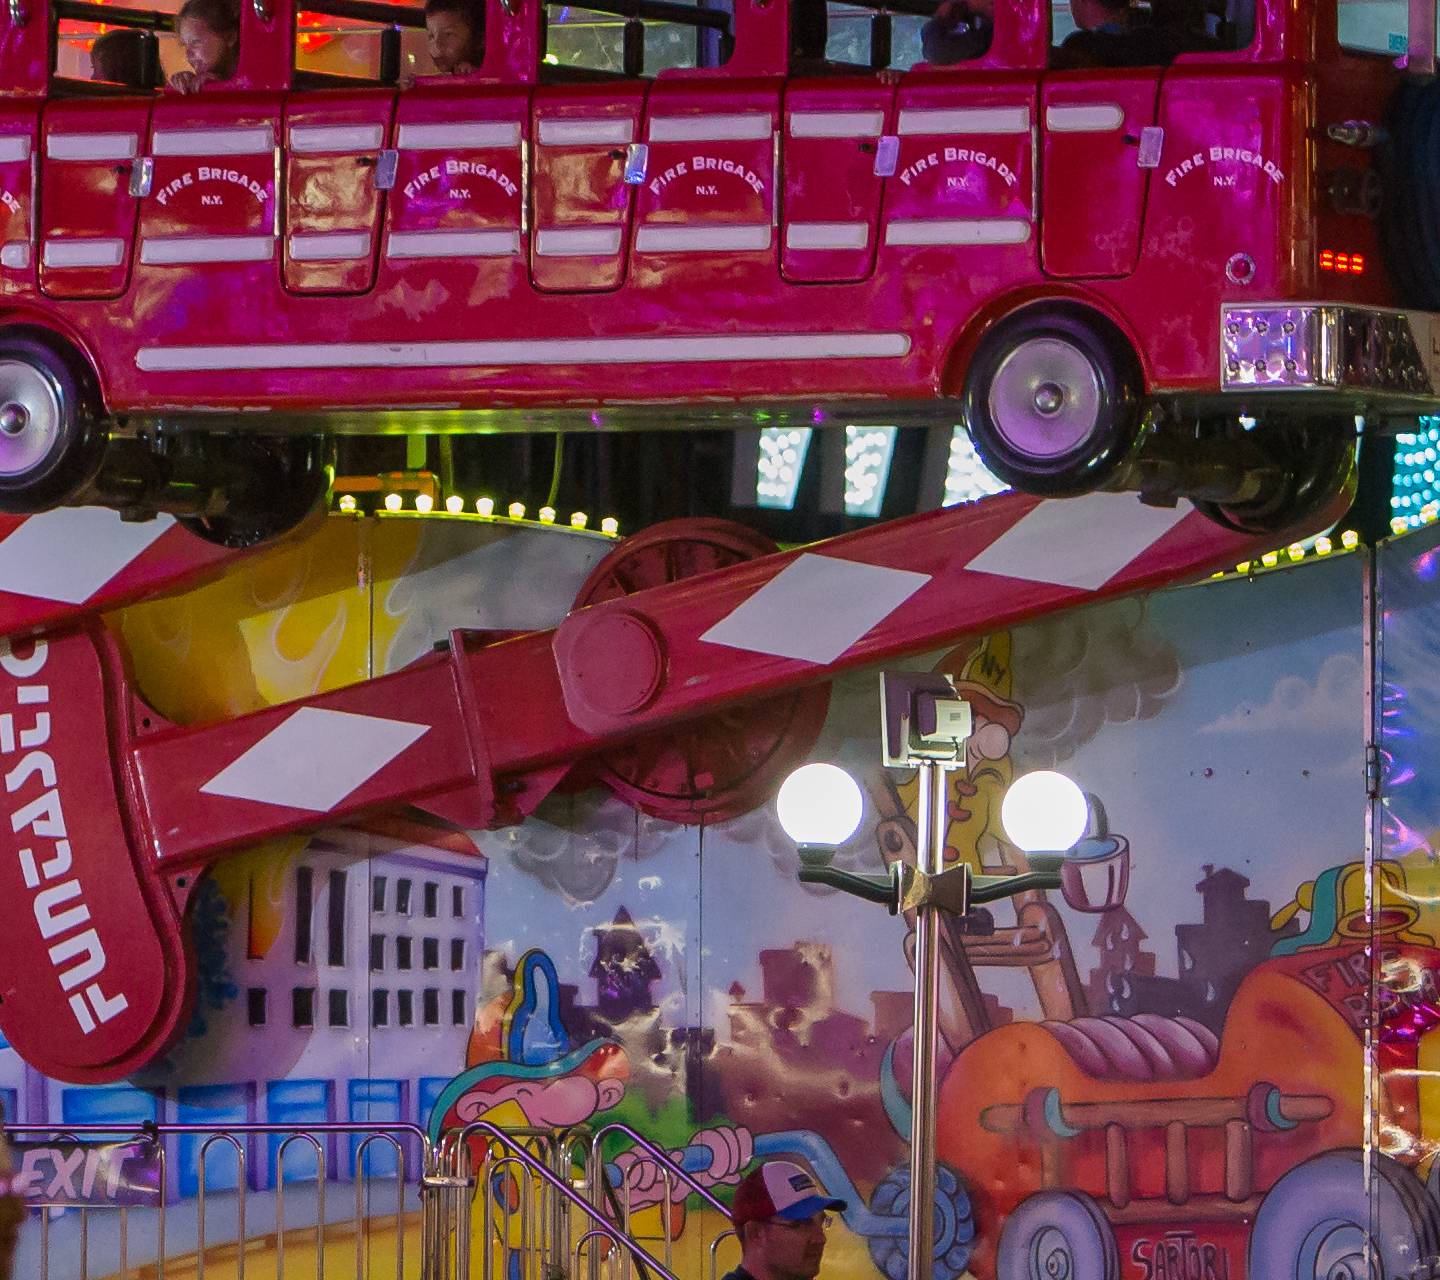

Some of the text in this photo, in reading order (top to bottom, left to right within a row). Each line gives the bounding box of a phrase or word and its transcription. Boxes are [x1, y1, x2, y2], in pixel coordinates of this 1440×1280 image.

[155, 166, 270, 206] FIRE BRIGADE
[403, 159, 519, 200] FIRE BRIGADE
[649, 156, 765, 196] FIRE BRIGADE
[899, 147, 1018, 187] FIRE BRIGADE
[1164, 146, 1285, 188] FIRE BRIGADE
[21, 1147, 135, 1199] EXIT
